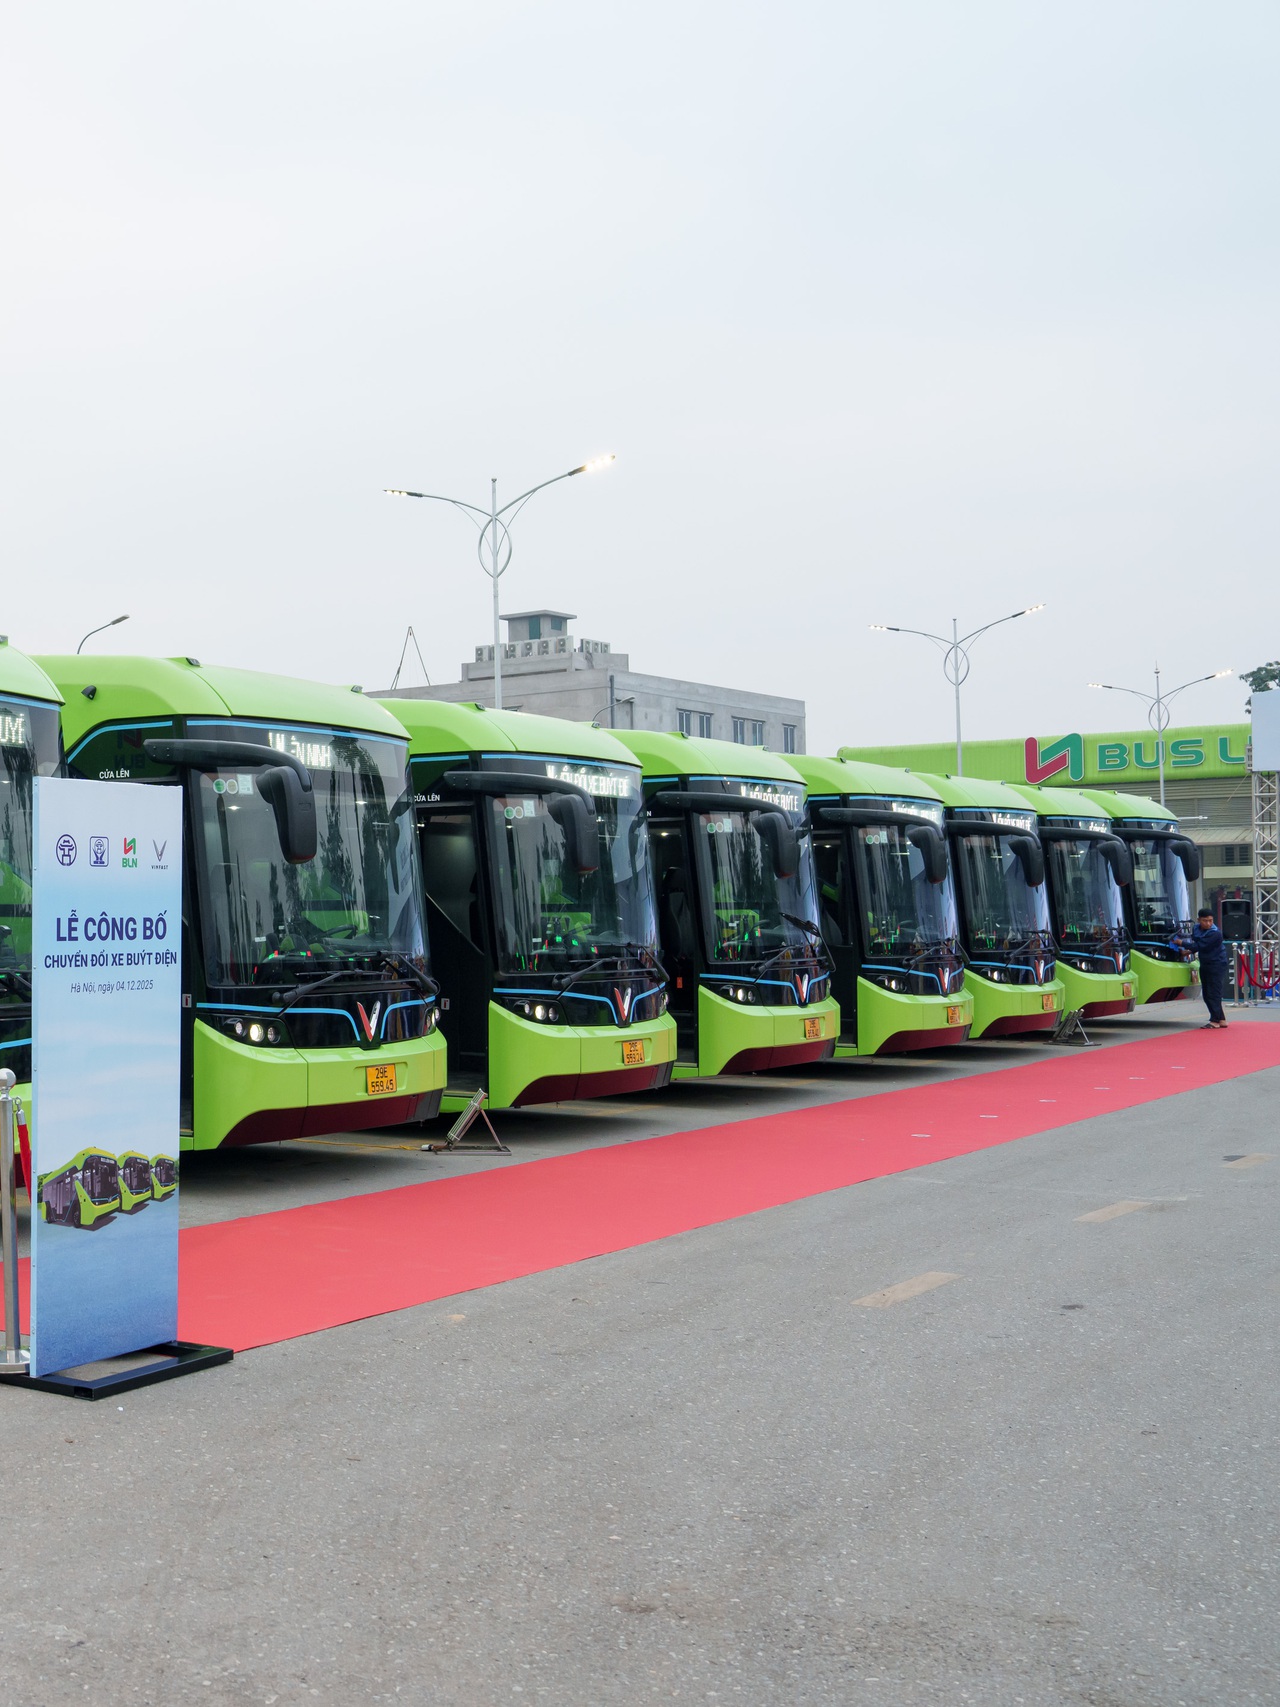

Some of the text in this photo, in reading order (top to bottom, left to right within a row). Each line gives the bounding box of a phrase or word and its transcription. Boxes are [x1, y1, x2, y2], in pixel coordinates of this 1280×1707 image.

[1097, 738, 1205, 771] BUS
[99, 768, 130, 779] CỬA LÊN
[427, 792, 440, 802] LÊN
[122, 858, 138, 868] BLN
[56, 909, 168, 942] LỄ CÔNG BỐ
[44, 949, 177, 969] CHUYỂN ĐỔI XE BUÝT ĐIỆN
[70, 980, 154, 995] Hà Nội, ngày 04.12.2025
[375, 1067, 388, 1079] 29E
[371, 1079, 394, 1093] 559.45
